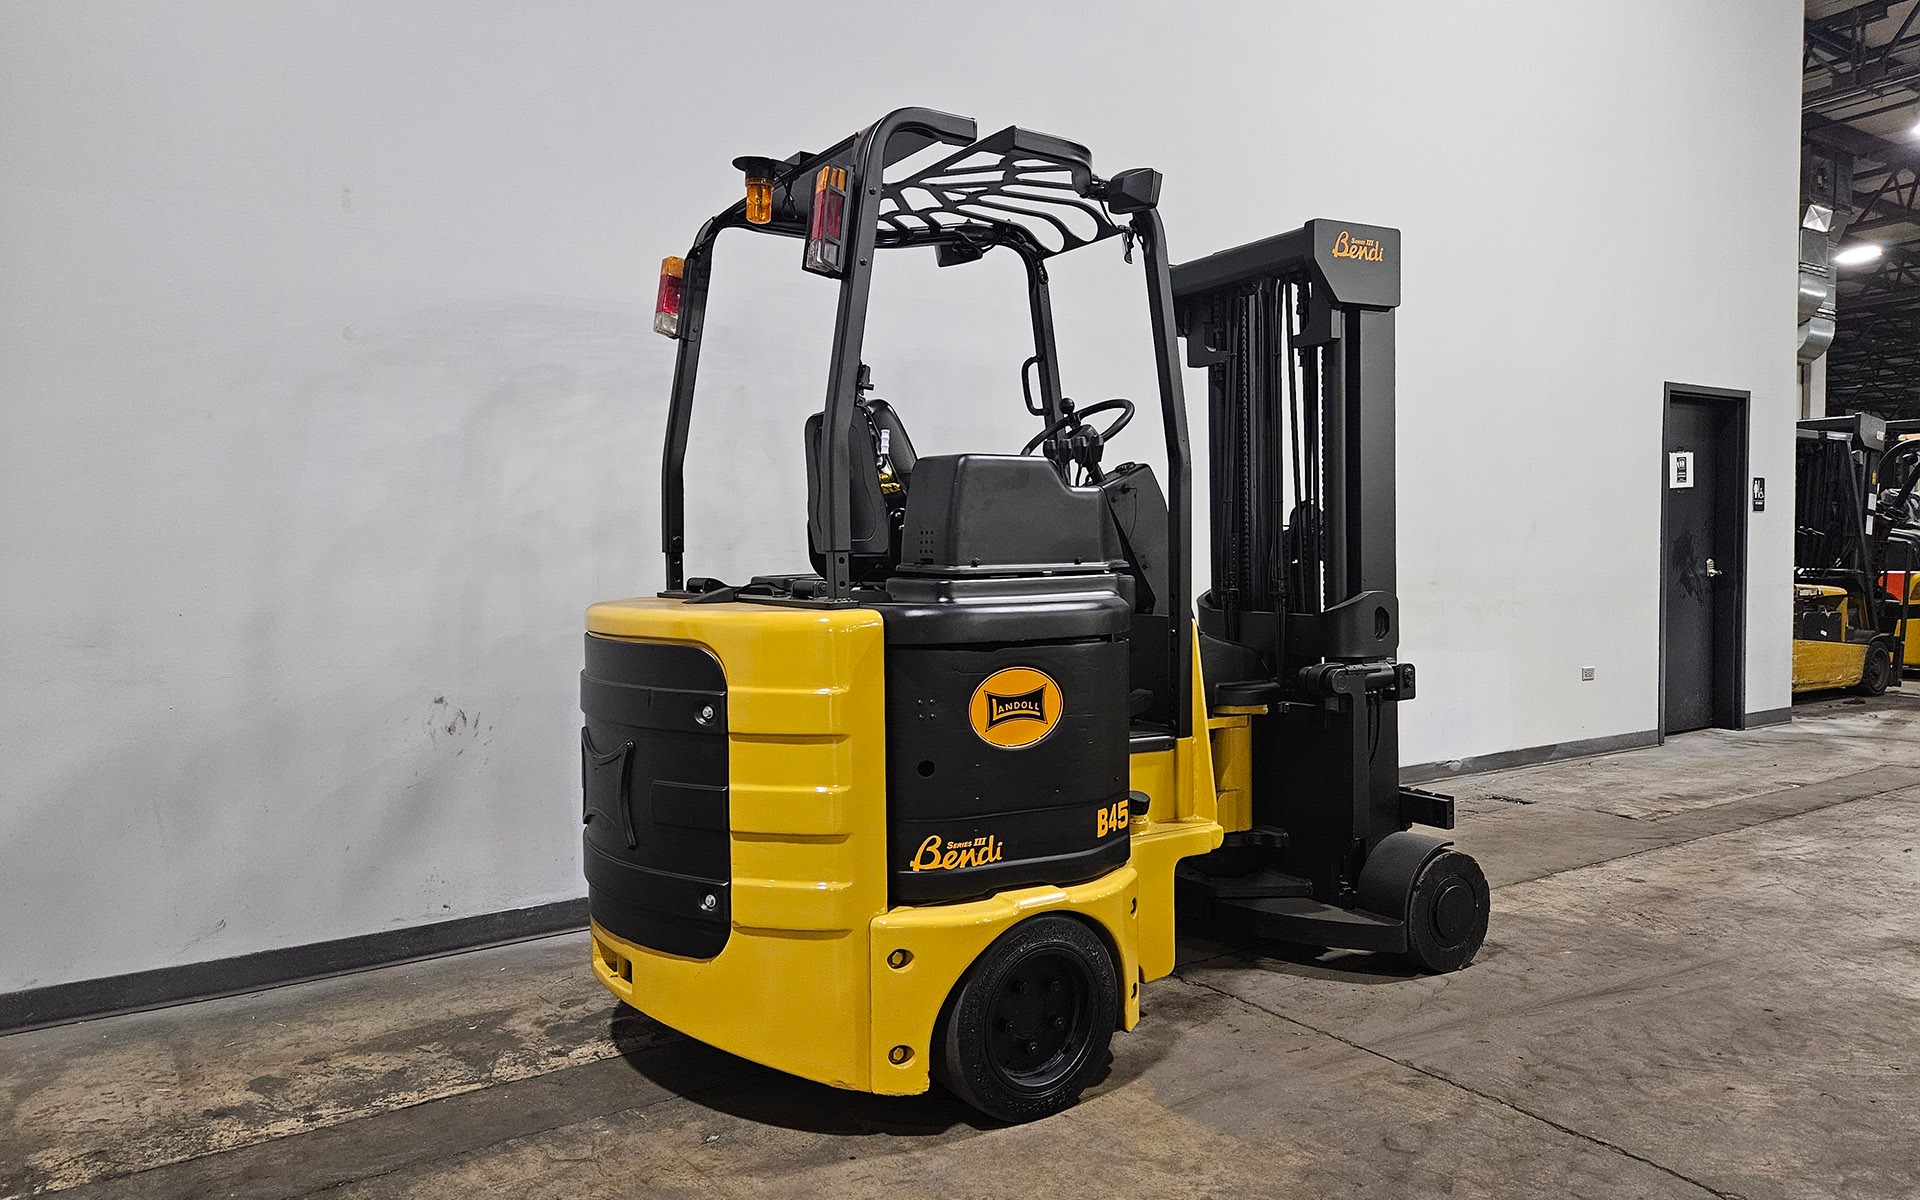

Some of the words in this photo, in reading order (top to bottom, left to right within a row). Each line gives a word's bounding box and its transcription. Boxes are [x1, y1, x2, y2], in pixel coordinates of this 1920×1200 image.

[1332, 230, 1384, 261] Bendi
[992, 699, 1040, 721] LANDOLL
[1097, 799, 1128, 838] B45
[910, 835, 1003, 872] Bendi
[973, 837, 987, 847] III
